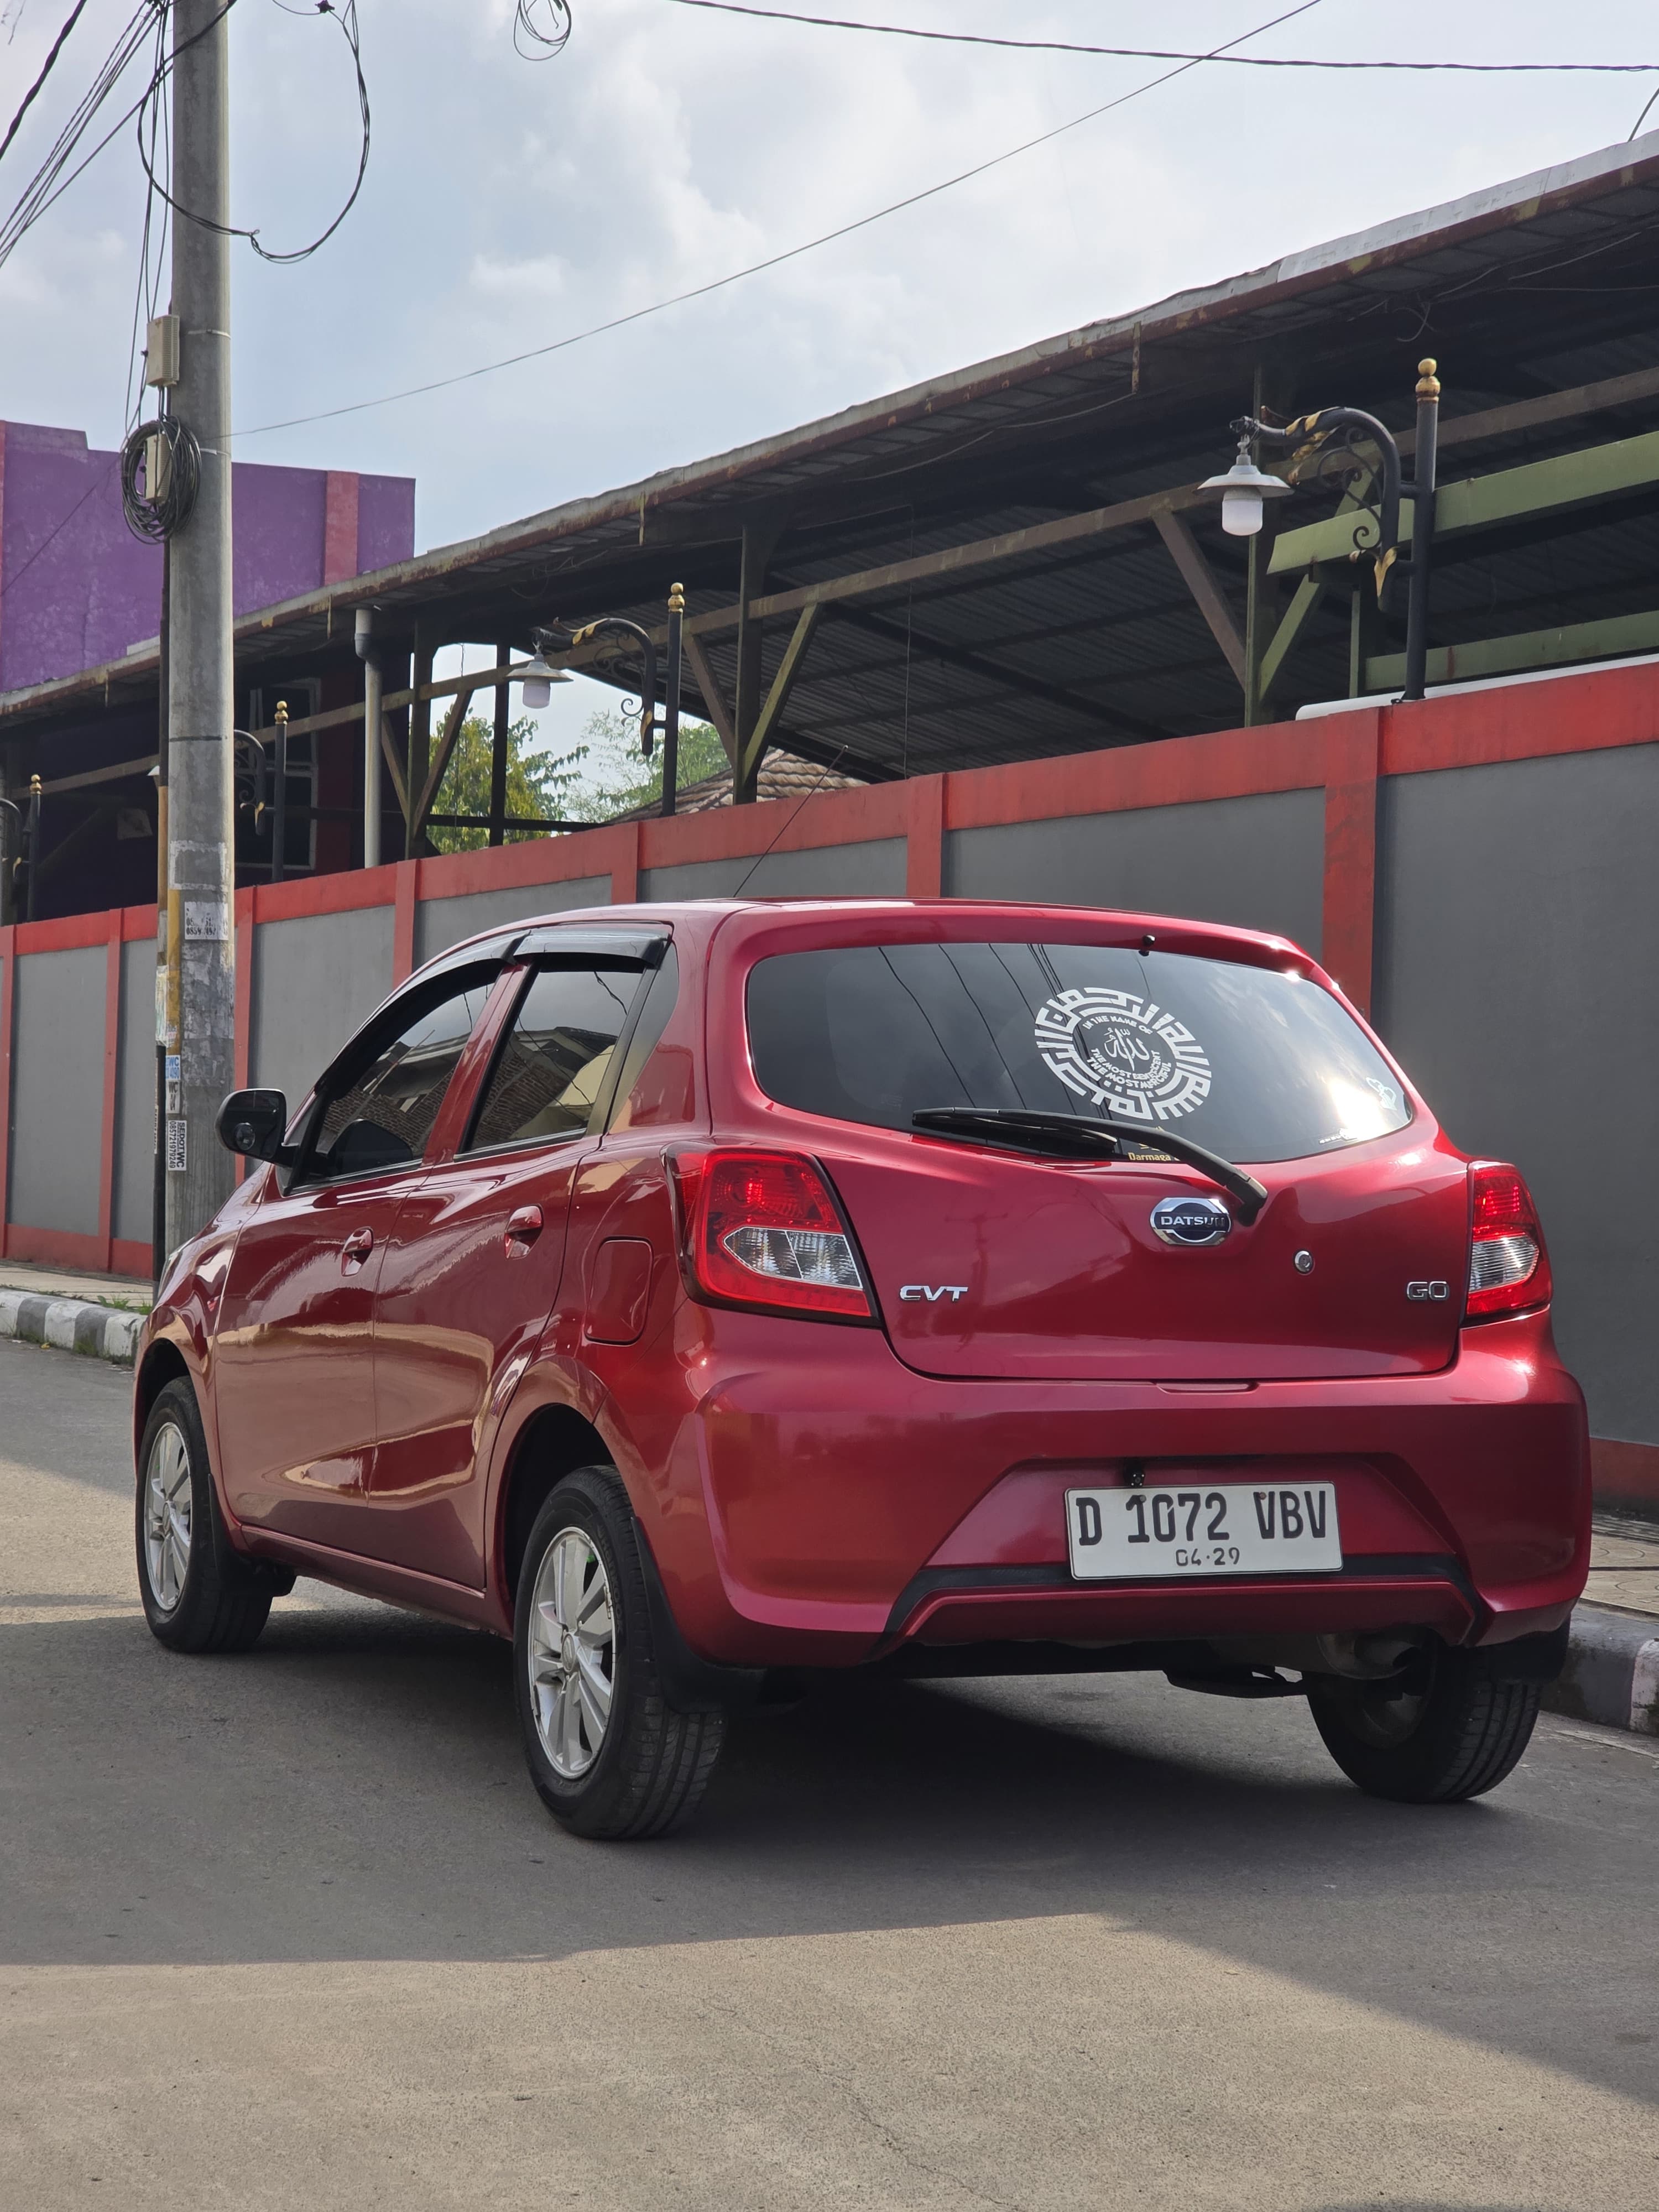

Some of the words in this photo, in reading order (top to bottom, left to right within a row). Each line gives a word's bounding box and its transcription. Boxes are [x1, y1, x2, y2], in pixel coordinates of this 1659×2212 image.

[1082, 1021, 1094, 1030] IN
[1091, 1016, 1109, 1024] THE
[1110, 1016, 1137, 1027] NAME
[1139, 1025, 1153, 1035] OF
[1087, 1057, 1108, 1075] THE
[1105, 1073, 1139, 1088] MOST
[1091, 1048, 1106, 1063] THE
[1105, 1062, 1132, 1078] MOST
[1128, 1152, 1171, 1161] Darmaga
[900, 1285, 968, 1302] CVT
[1407, 1281, 1449, 1301] GO
[1076, 1497, 1102, 1546] D
[1126, 1492, 1229, 1543] 1072
[1253, 1491, 1326, 1539] VBV
